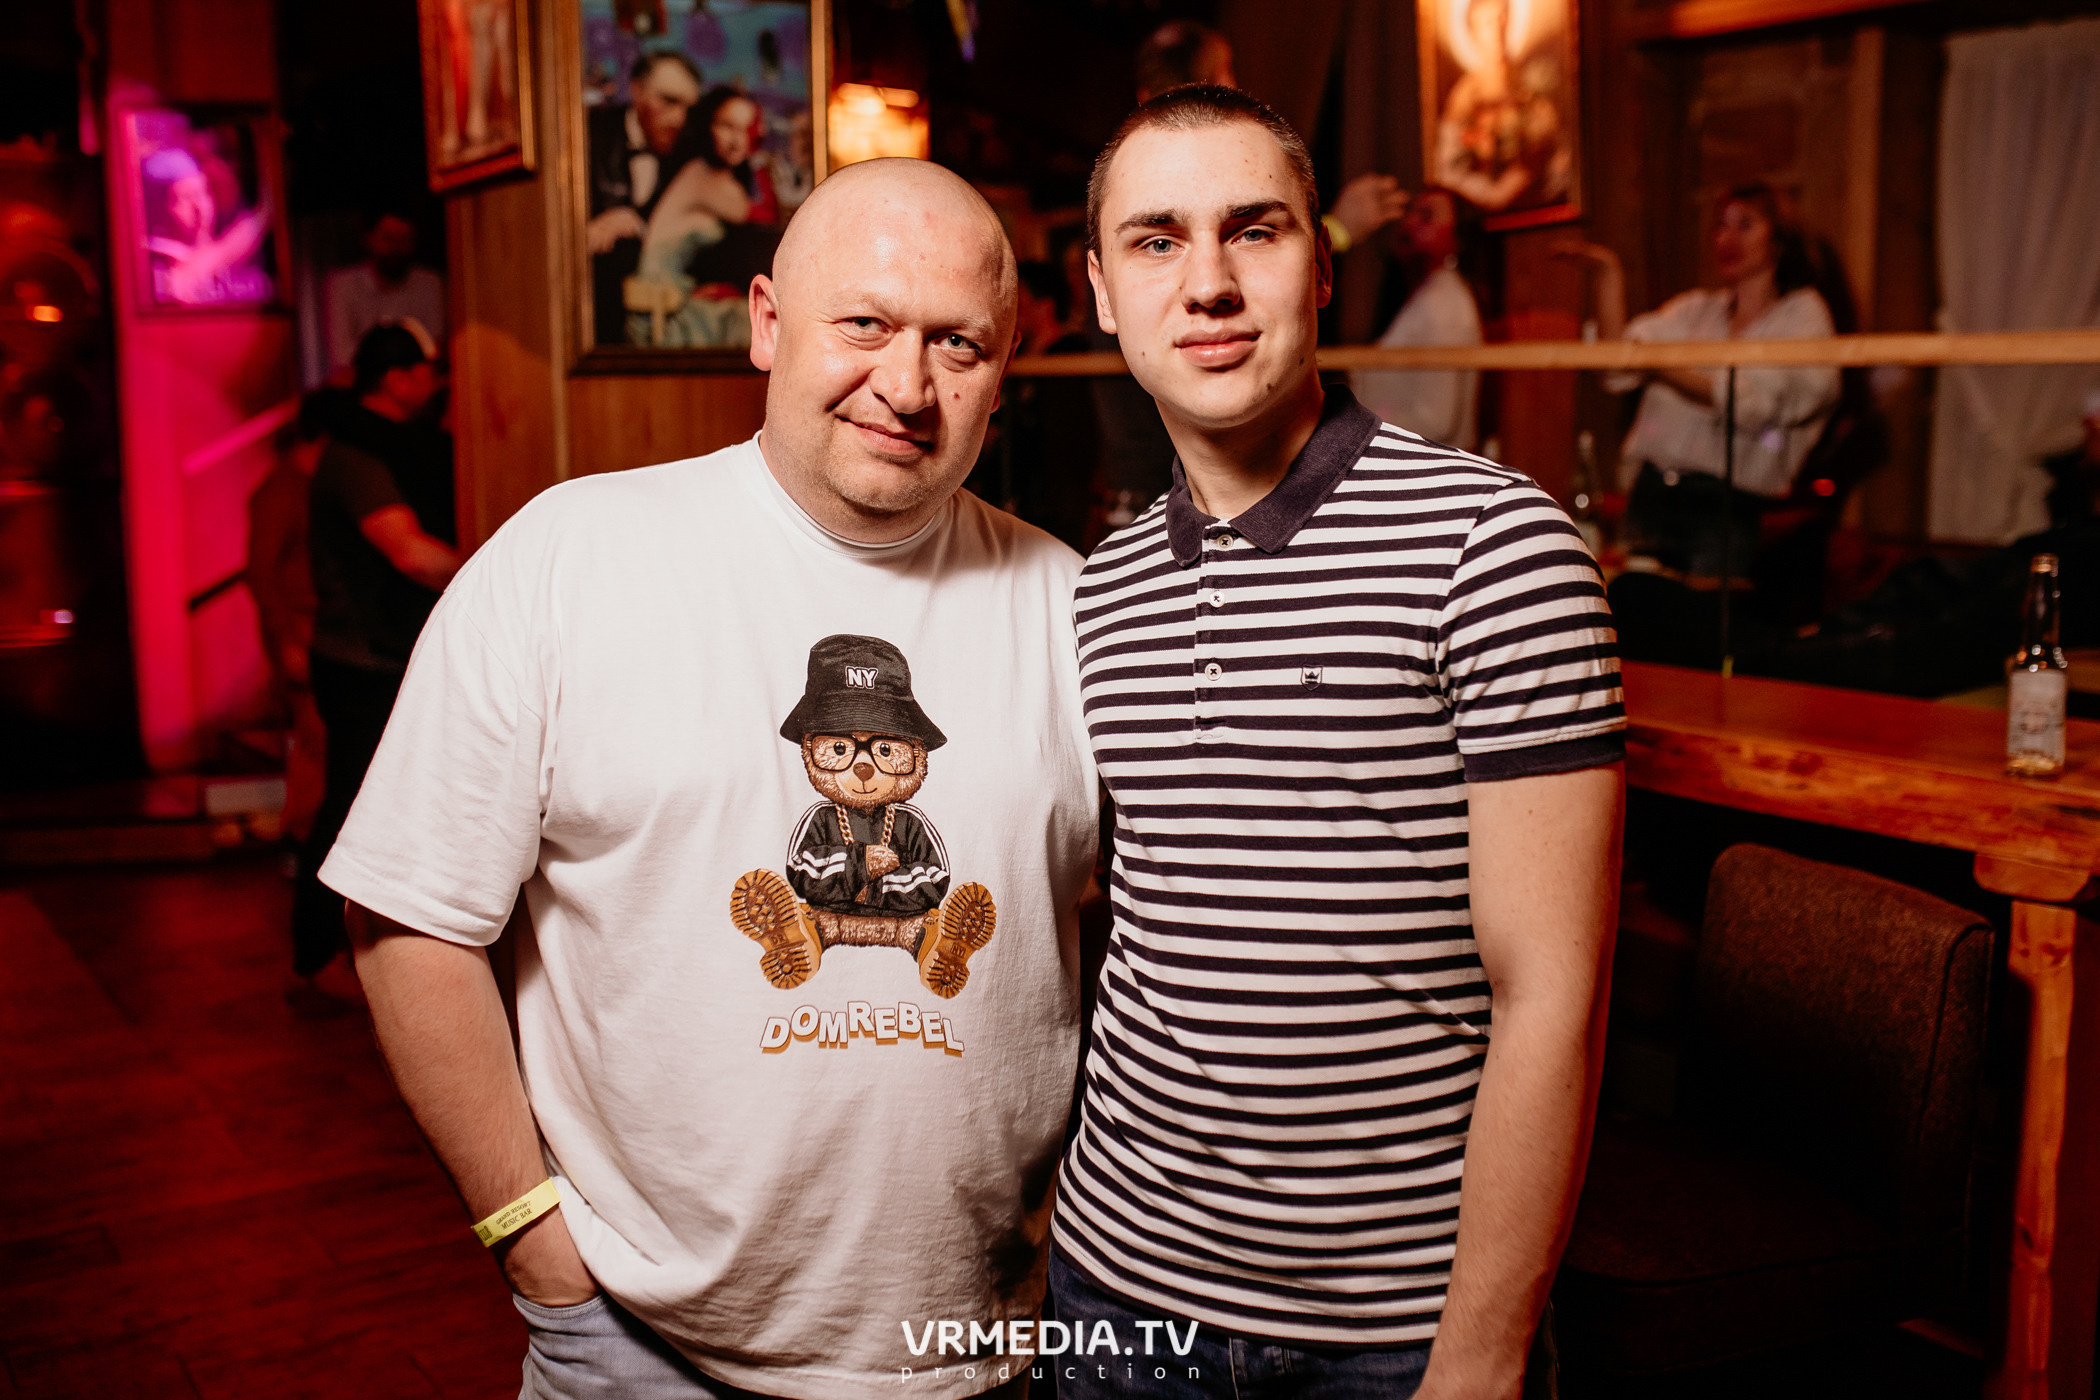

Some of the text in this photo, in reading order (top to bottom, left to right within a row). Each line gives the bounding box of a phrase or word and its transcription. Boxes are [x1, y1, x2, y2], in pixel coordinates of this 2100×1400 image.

[846, 666, 878, 689] NY
[760, 1001, 965, 1057] DOMREBEL
[495, 1201, 531, 1225] GRAND RESORT
[501, 1208, 532, 1230] MUSIC BAR
